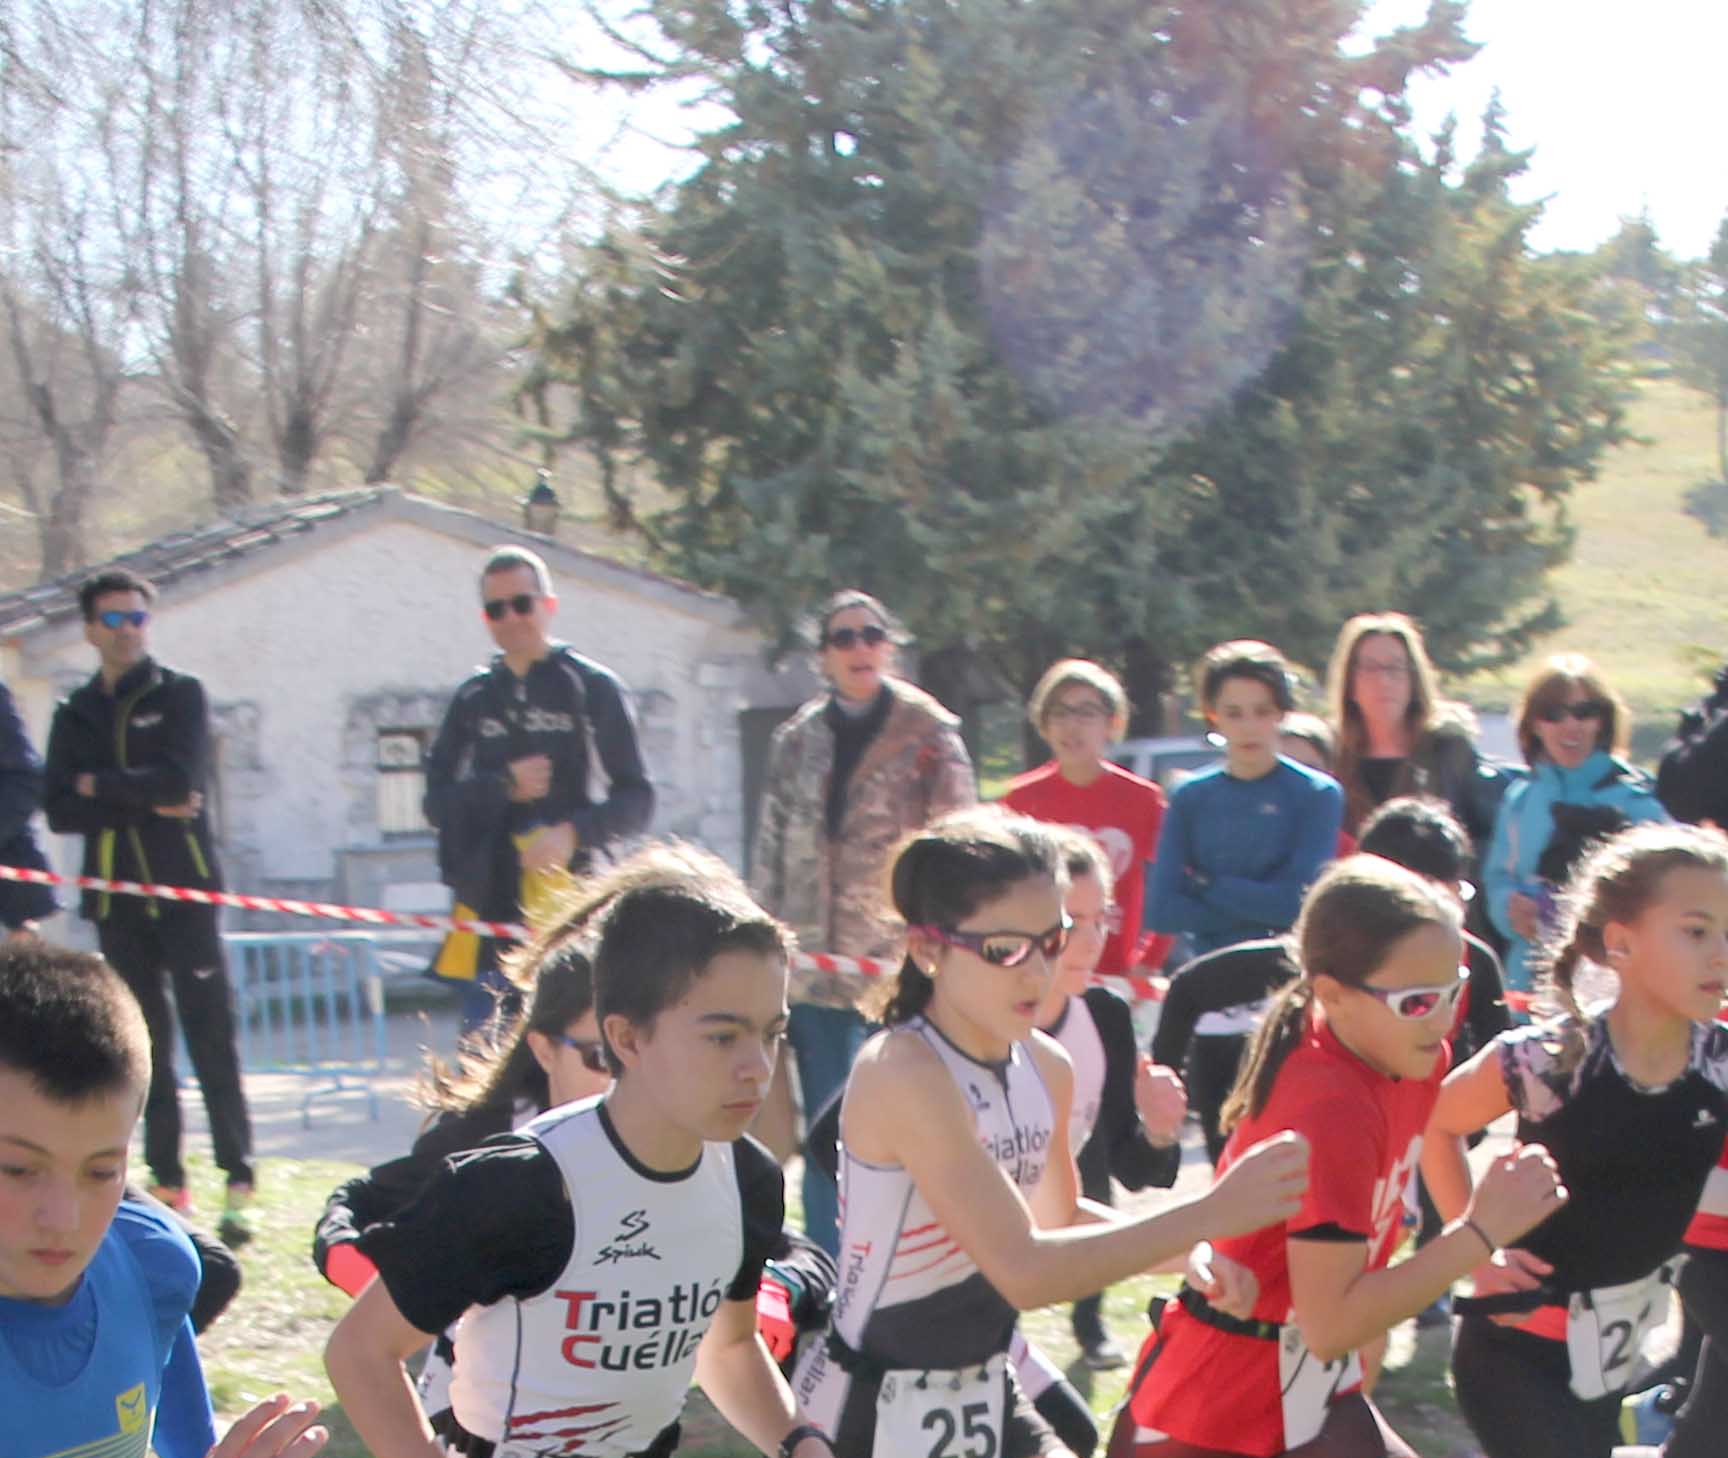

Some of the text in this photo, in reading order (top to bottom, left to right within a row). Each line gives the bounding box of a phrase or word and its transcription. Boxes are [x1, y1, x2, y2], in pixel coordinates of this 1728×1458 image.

[592, 1242, 662, 1266] Spiuk
[554, 1278, 723, 1331] Triatló
[561, 1329, 706, 1371] Cuélla
